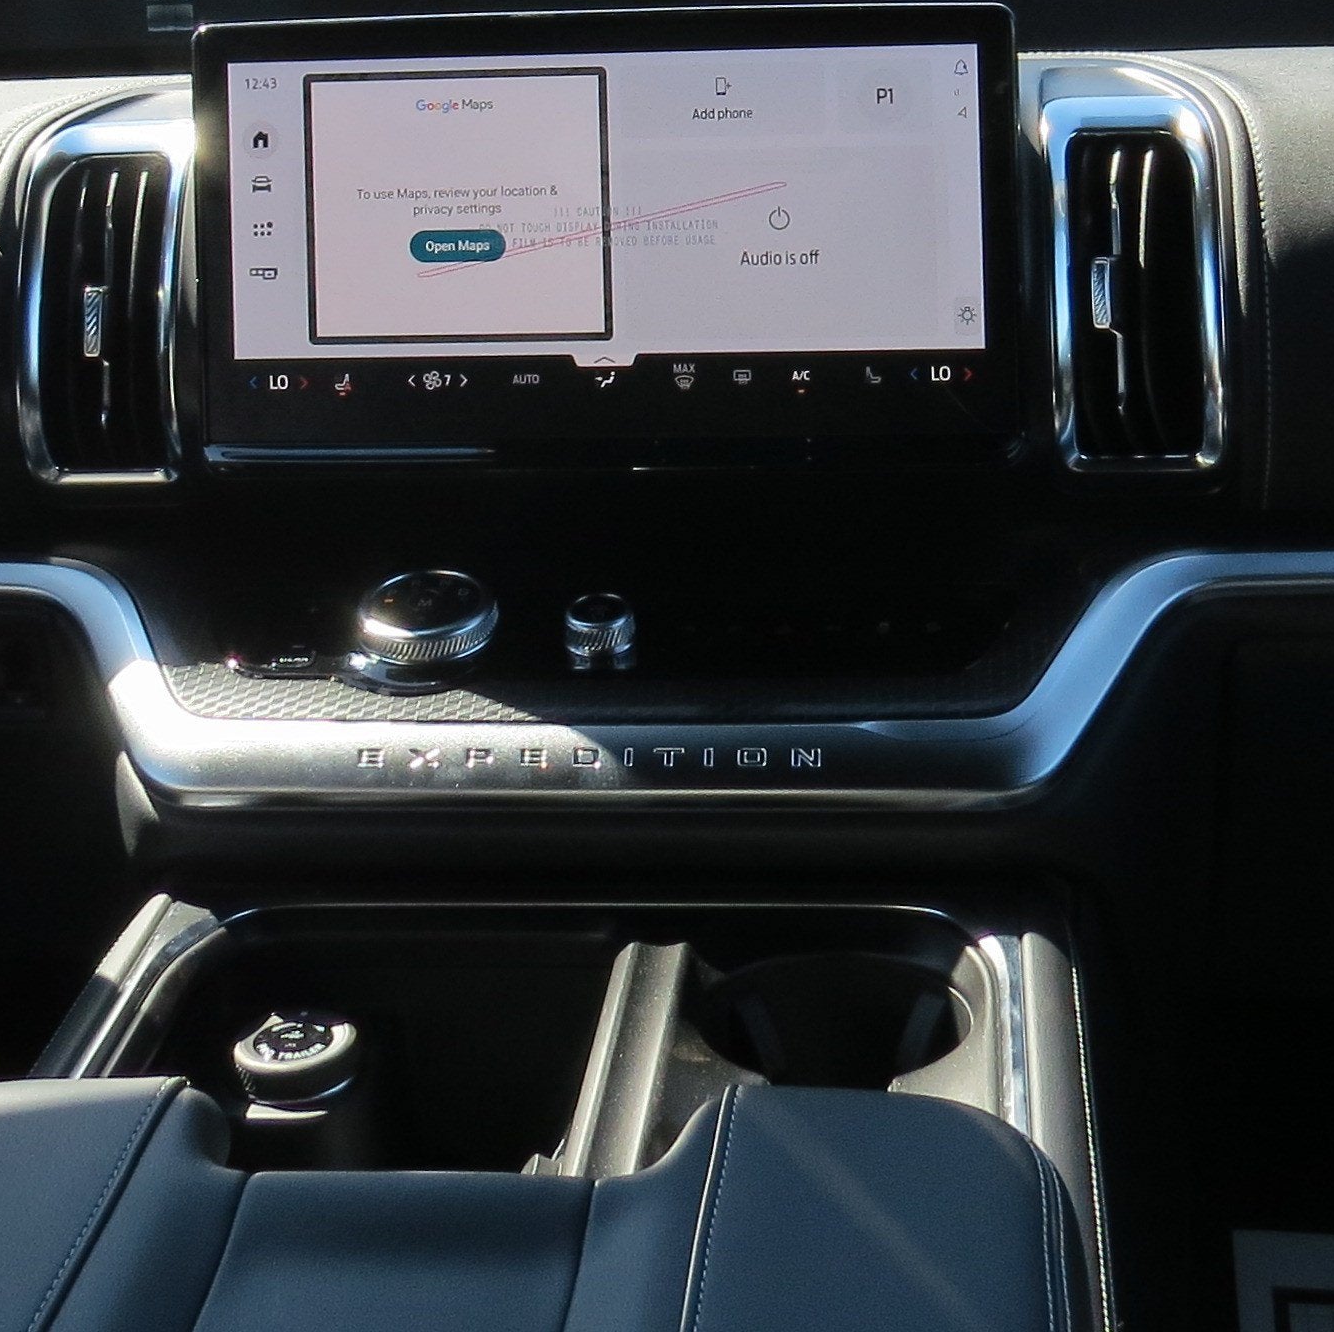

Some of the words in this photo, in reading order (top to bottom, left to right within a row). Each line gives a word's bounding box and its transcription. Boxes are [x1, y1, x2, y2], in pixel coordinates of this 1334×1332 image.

[244, 77, 278, 91] 12:43
[876, 87, 894, 105] P1
[415, 99, 459, 114] Google
[461, 98, 494, 112] Maps
[692, 107, 715, 120] Add
[717, 107, 753, 122] phone
[357, 189, 371, 201] To
[373, 190, 394, 200] use
[396, 187, 431, 202] Maps,
[433, 187, 470, 199] review
[472, 187, 499, 202] your
[500, 184, 547, 198] location
[549, 184, 558, 197] &
[413, 203, 454, 218] privacy
[456, 202, 502, 217] settings
[522, 222, 551, 234] TOUCH
[646, 220, 719, 232] INSTALLATION
[425, 241, 457, 255] Open
[458, 240, 490, 254] Maps
[644, 235, 679, 246] BEFORE
[685, 234, 716, 246] USAGE
[739, 249, 783, 267] Audio
[785, 250, 797, 265] is
[799, 249, 821, 265] off
[672, 362, 696, 373] MAX
[930, 365, 951, 382] LO
[269, 374, 289, 390] LO
[444, 374, 451, 386] 7
[512, 374, 540, 385] AUTO
[791, 370, 811, 381] A/C
[358, 746, 823, 769] EXPEDITION
